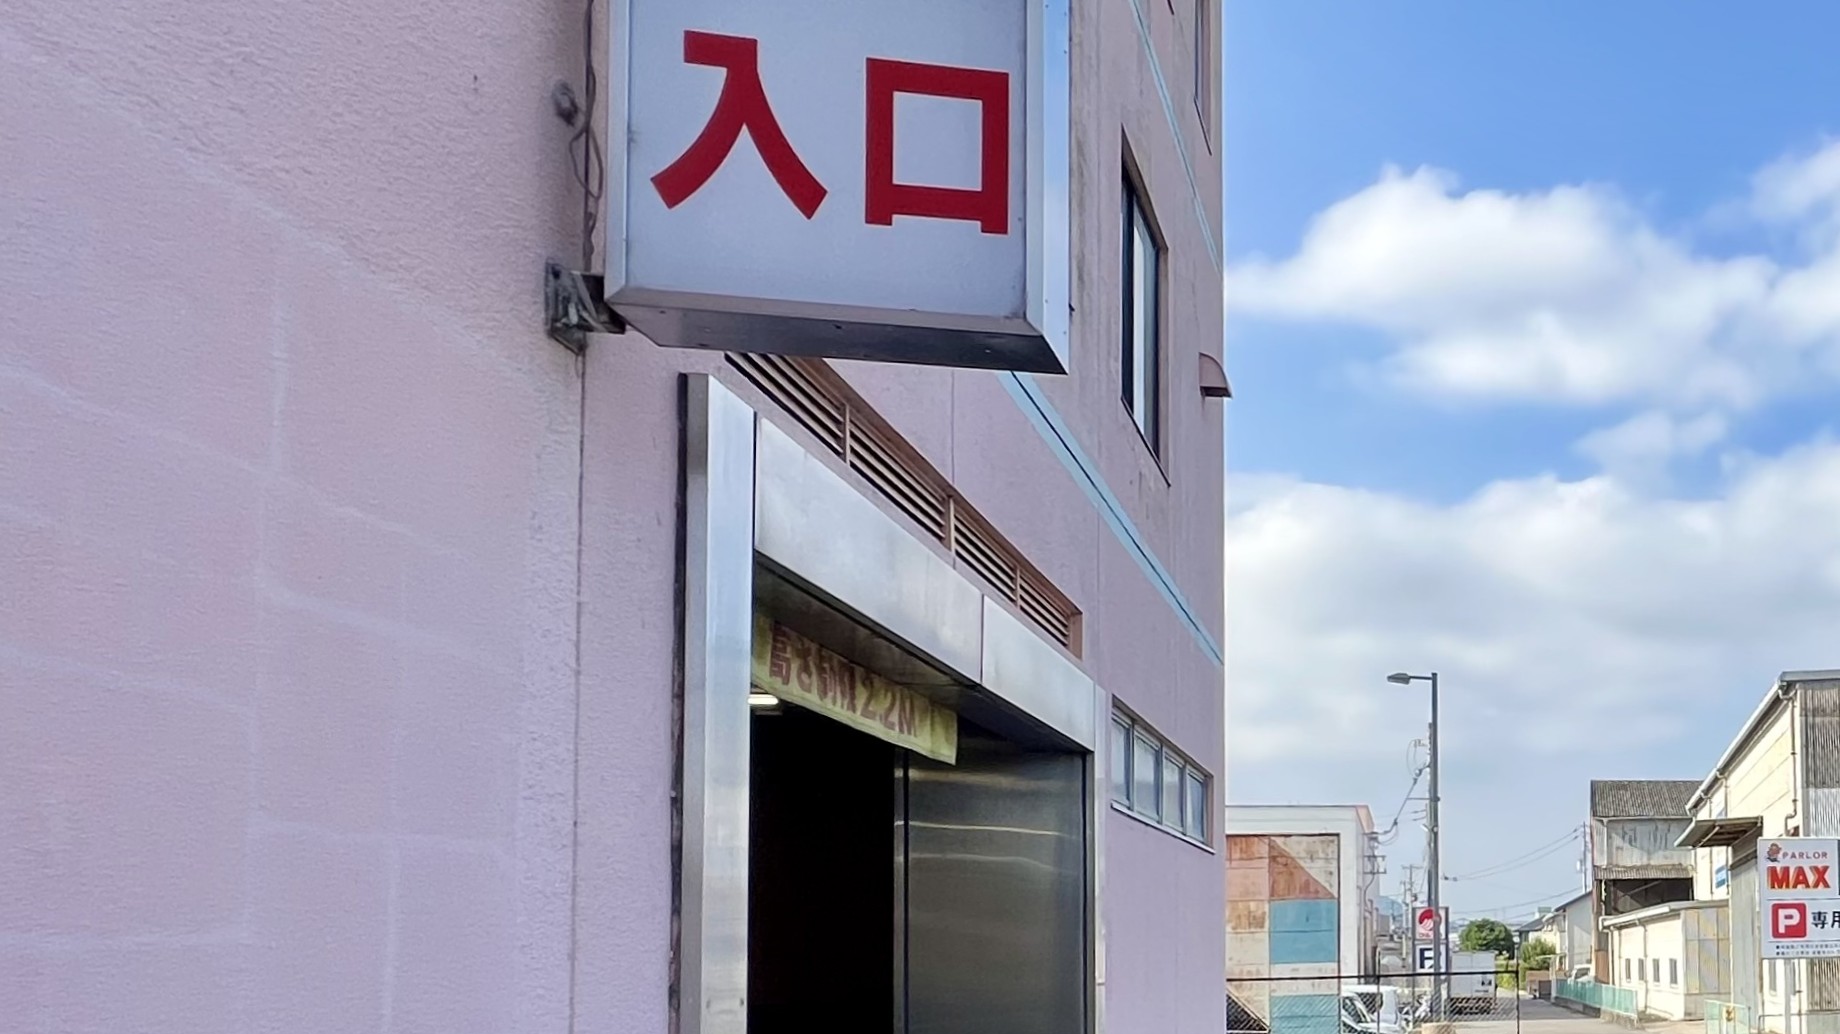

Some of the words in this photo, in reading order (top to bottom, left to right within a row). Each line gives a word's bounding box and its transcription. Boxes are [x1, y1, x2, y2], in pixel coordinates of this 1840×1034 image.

[650, 29, 1010, 235] 入口
[1782, 851, 1828, 860] PARLOR
[1766, 865, 1831, 890] MAX
[1777, 908, 1800, 934] P
